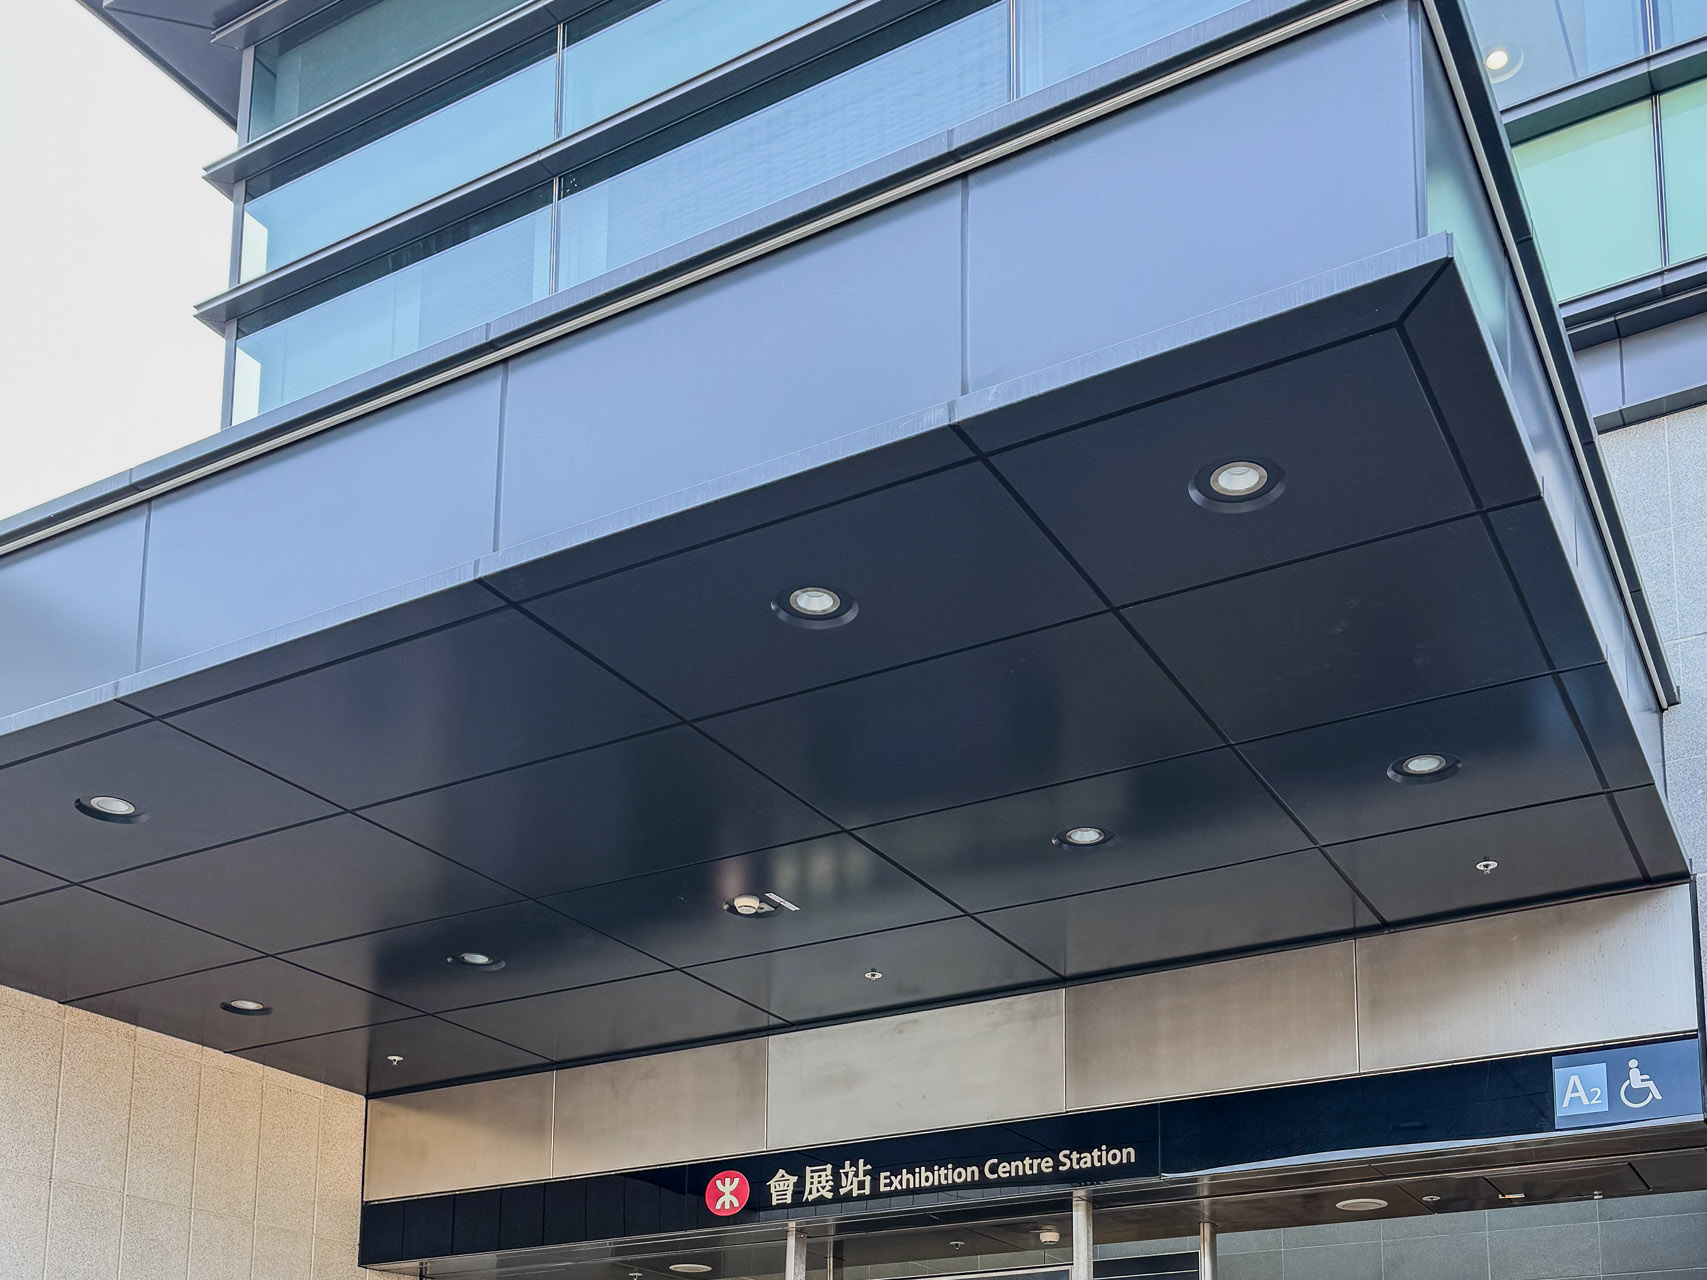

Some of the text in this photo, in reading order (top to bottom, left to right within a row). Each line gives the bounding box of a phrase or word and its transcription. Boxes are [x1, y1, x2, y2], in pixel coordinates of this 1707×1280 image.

[1562, 1074, 1603, 1108] A2
[766, 1158, 872, 1206] 會展站
[879, 1145, 1136, 1192] Exhibition Centre Station
